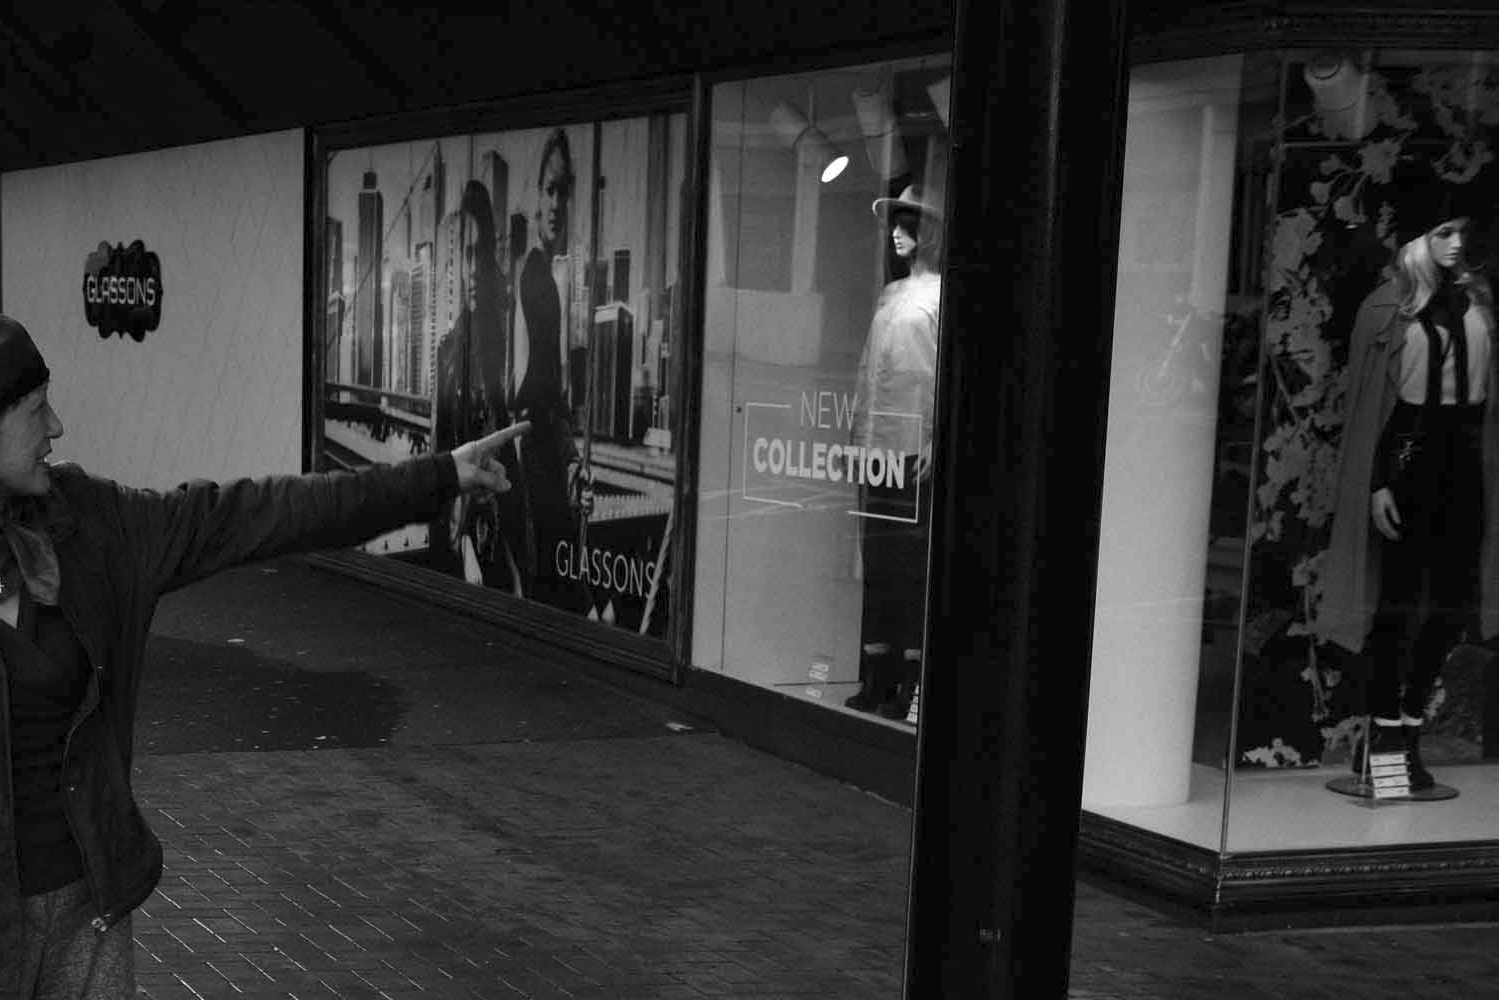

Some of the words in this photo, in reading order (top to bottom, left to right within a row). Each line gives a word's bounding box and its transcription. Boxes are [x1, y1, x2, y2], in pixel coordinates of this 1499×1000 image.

[86, 275, 156, 306] GLASSONS
[800, 391, 858, 431] NEW
[754, 436, 906, 489] COLLECTION
[555, 540, 656, 600] GLASSONS
